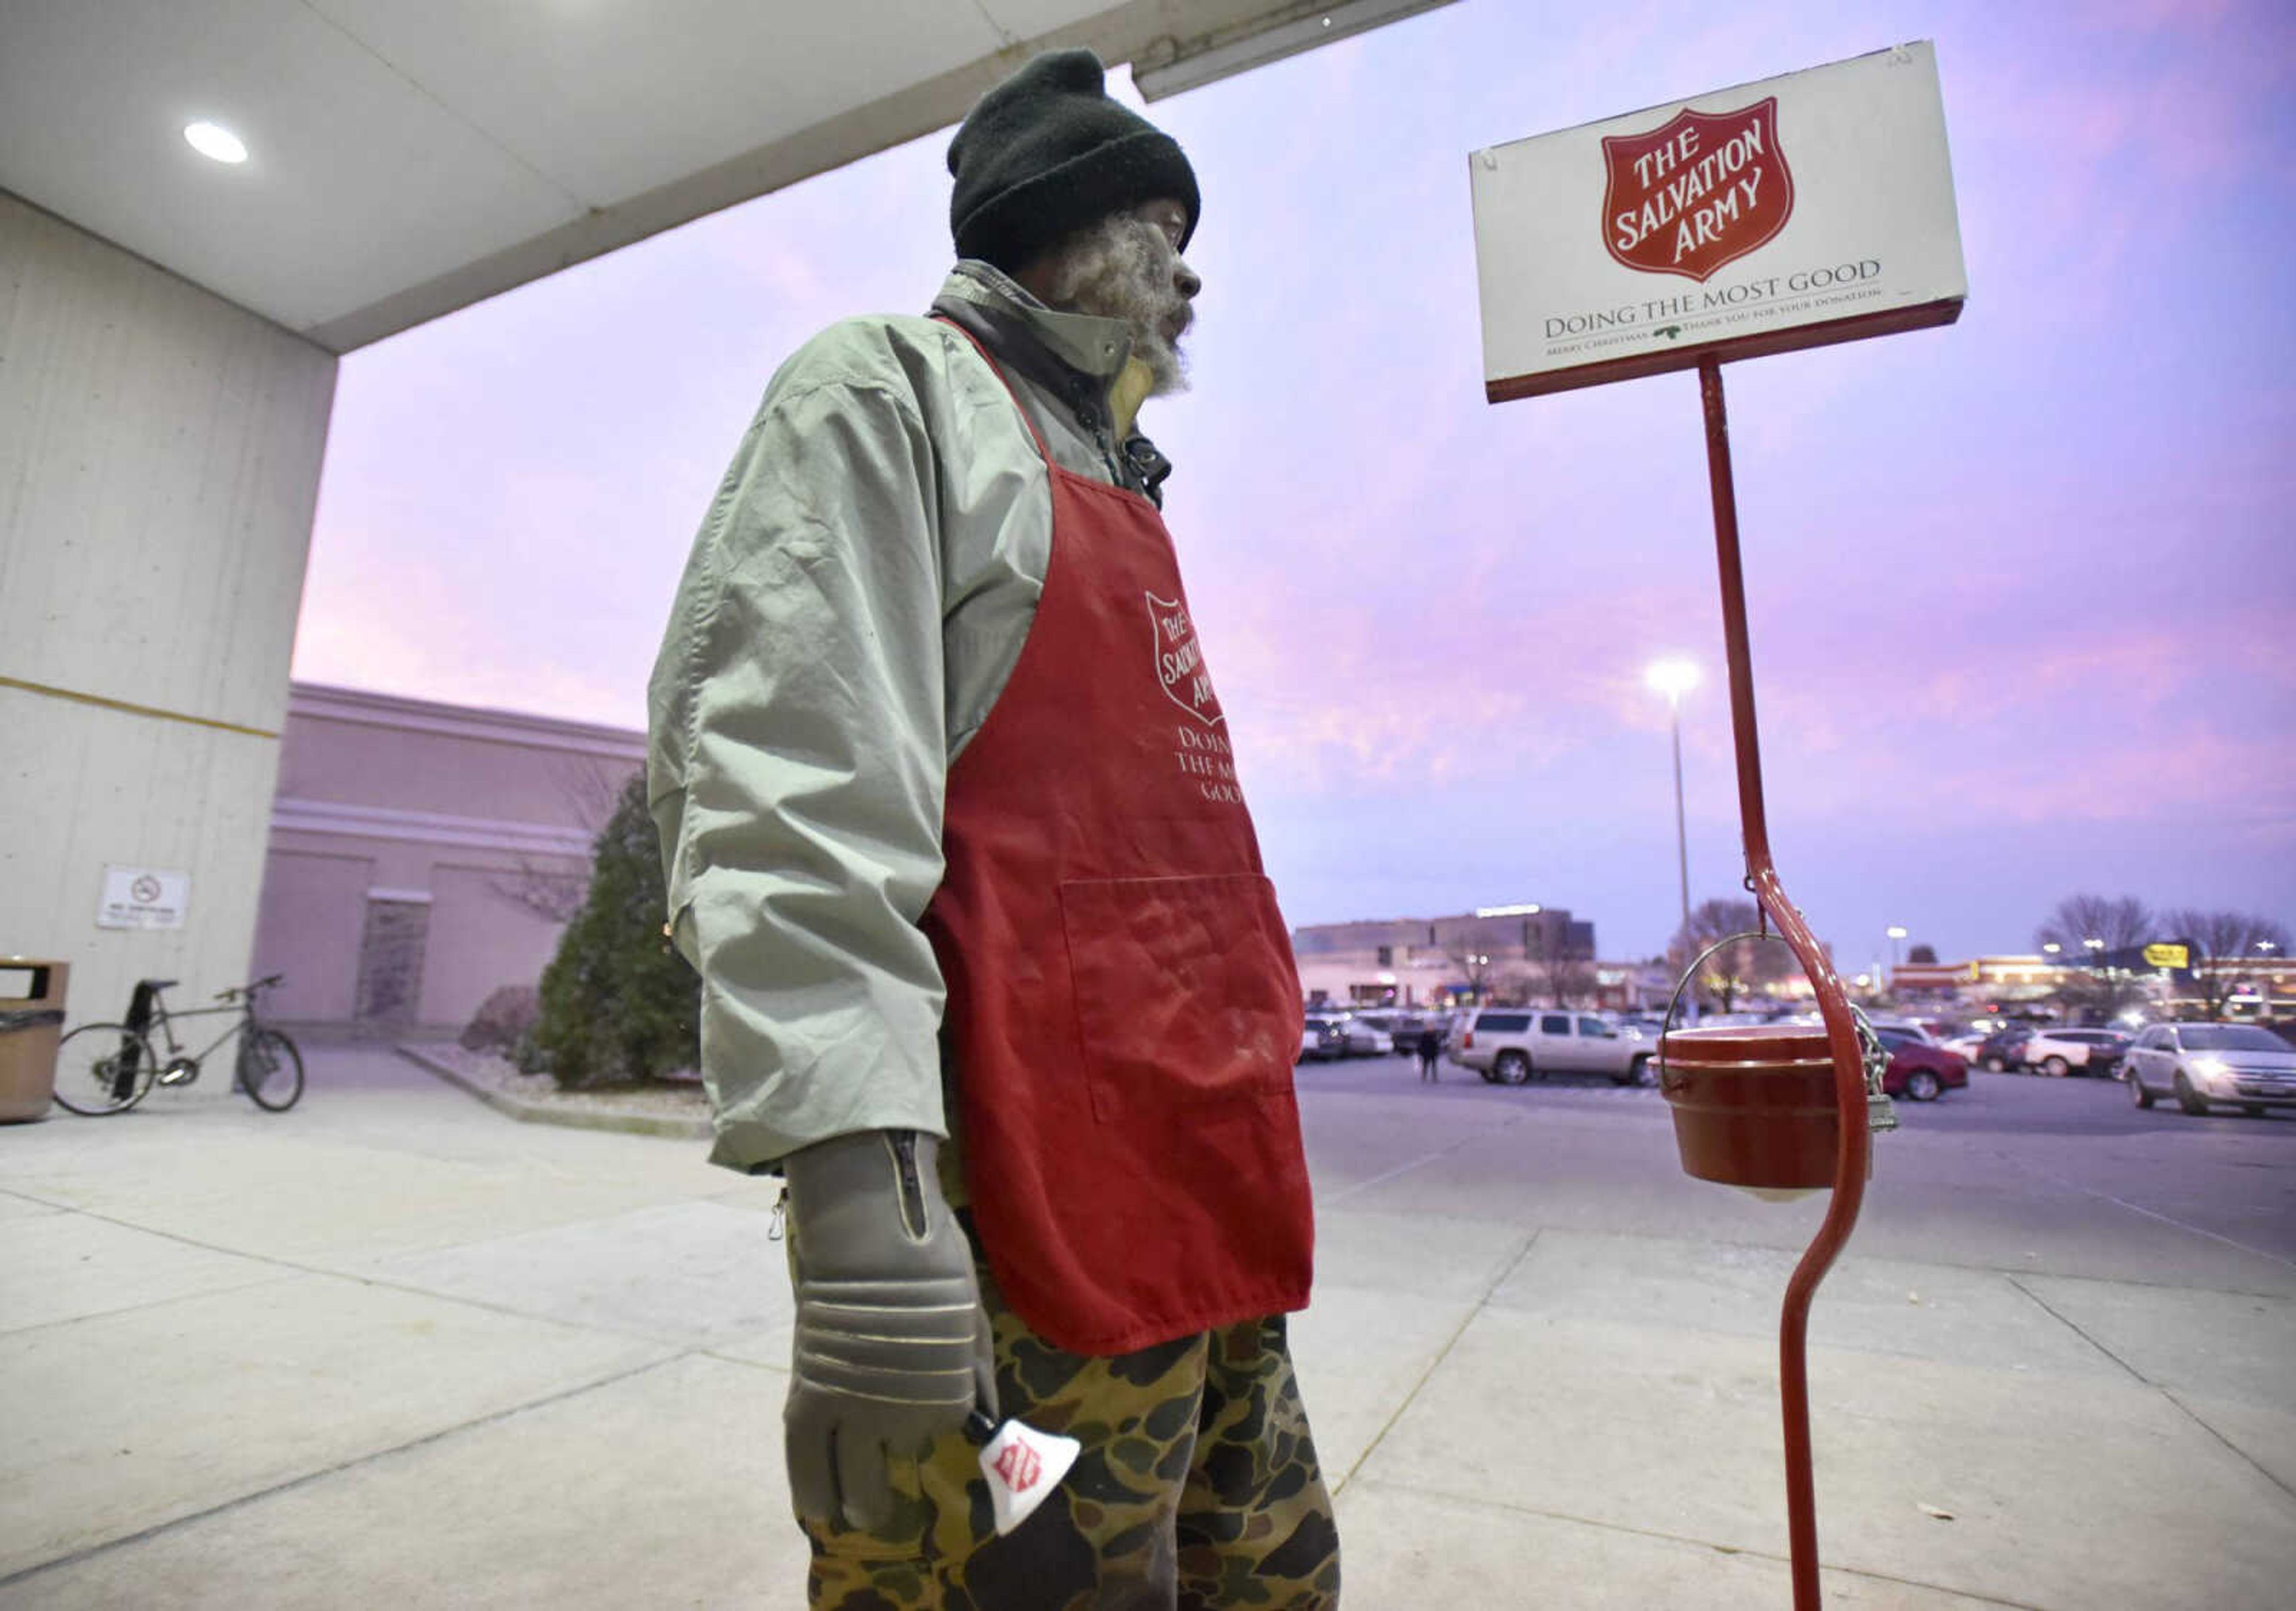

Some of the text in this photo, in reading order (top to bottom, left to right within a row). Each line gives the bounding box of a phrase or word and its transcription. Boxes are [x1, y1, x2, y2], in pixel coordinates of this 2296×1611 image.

[1616, 118, 1764, 252] SALVATION
[1634, 126, 1700, 189] THE
[1674, 166, 1761, 264] ARMY
[1545, 259, 1881, 339] DOING THE MOST GOOD
[1683, 316, 1722, 332] THANK
[1726, 311, 1750, 324] YOU
[1752, 307, 1776, 319] FOR
[1779, 301, 1812, 315] YOUR
[1815, 289, 1882, 308] DONATION
[1162, 612, 1187, 641] THE
[1173, 751, 1213, 776] THE
